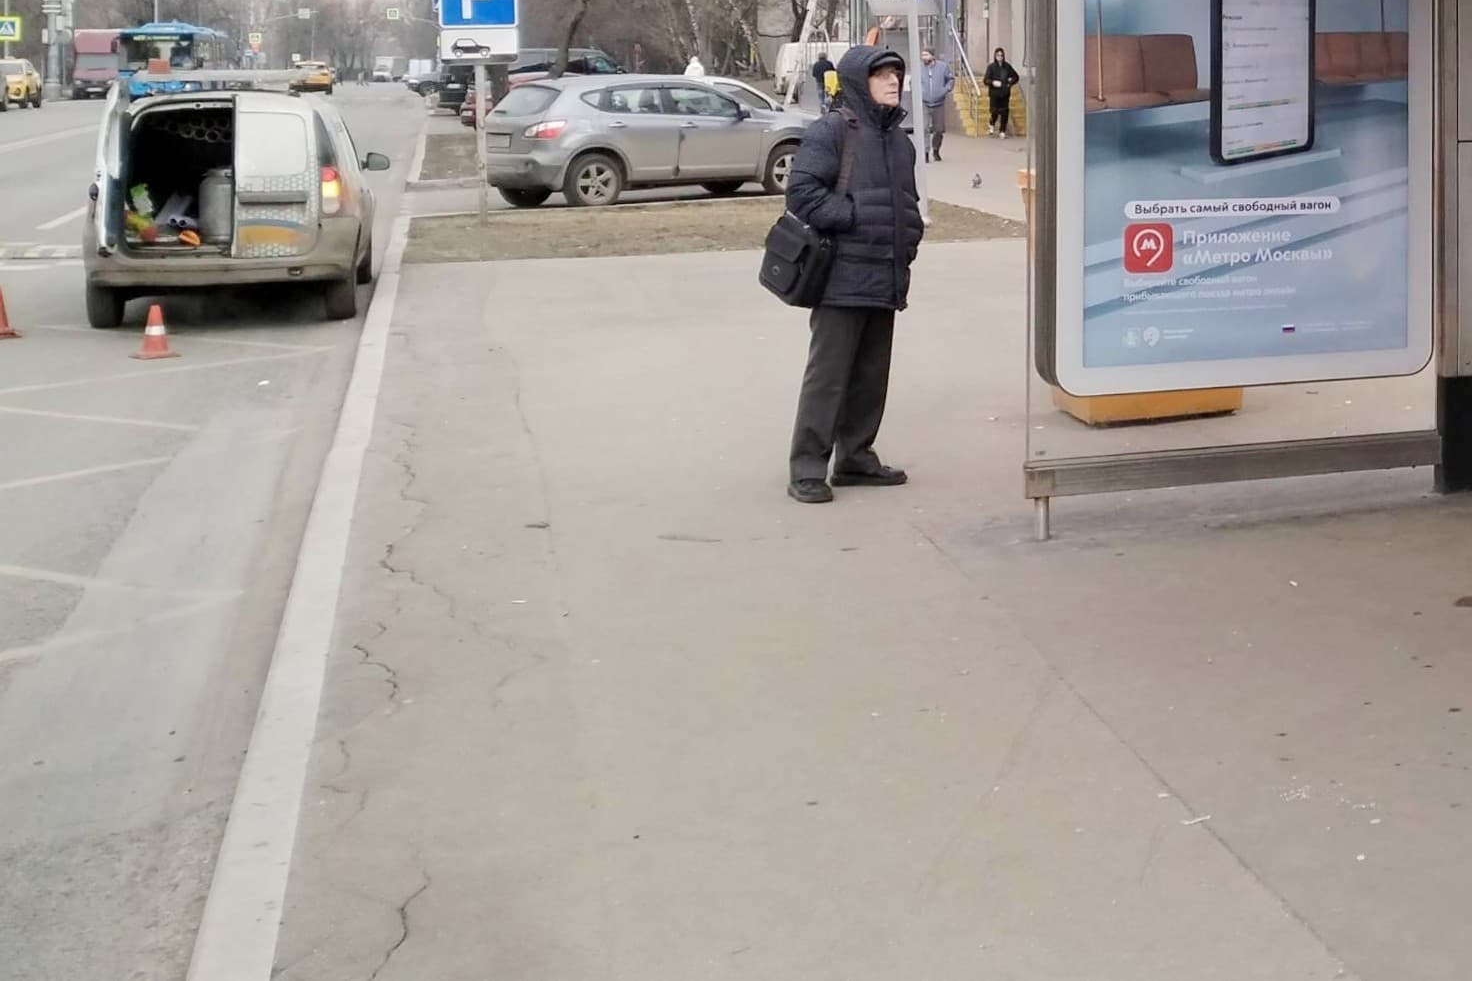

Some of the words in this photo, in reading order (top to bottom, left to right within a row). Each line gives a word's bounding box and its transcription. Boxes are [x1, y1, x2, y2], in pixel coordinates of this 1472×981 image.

[1134, 203, 1187, 216] Выбрать
[1190, 200, 1229, 213] самый
[1232, 199, 1297, 213] свободный
[1300, 200, 1332, 211] вагон
[1183, 230, 1292, 248] Приложение
[1183, 249, 1250, 268] «Метро
[1255, 248, 1333, 263] Москвы»
